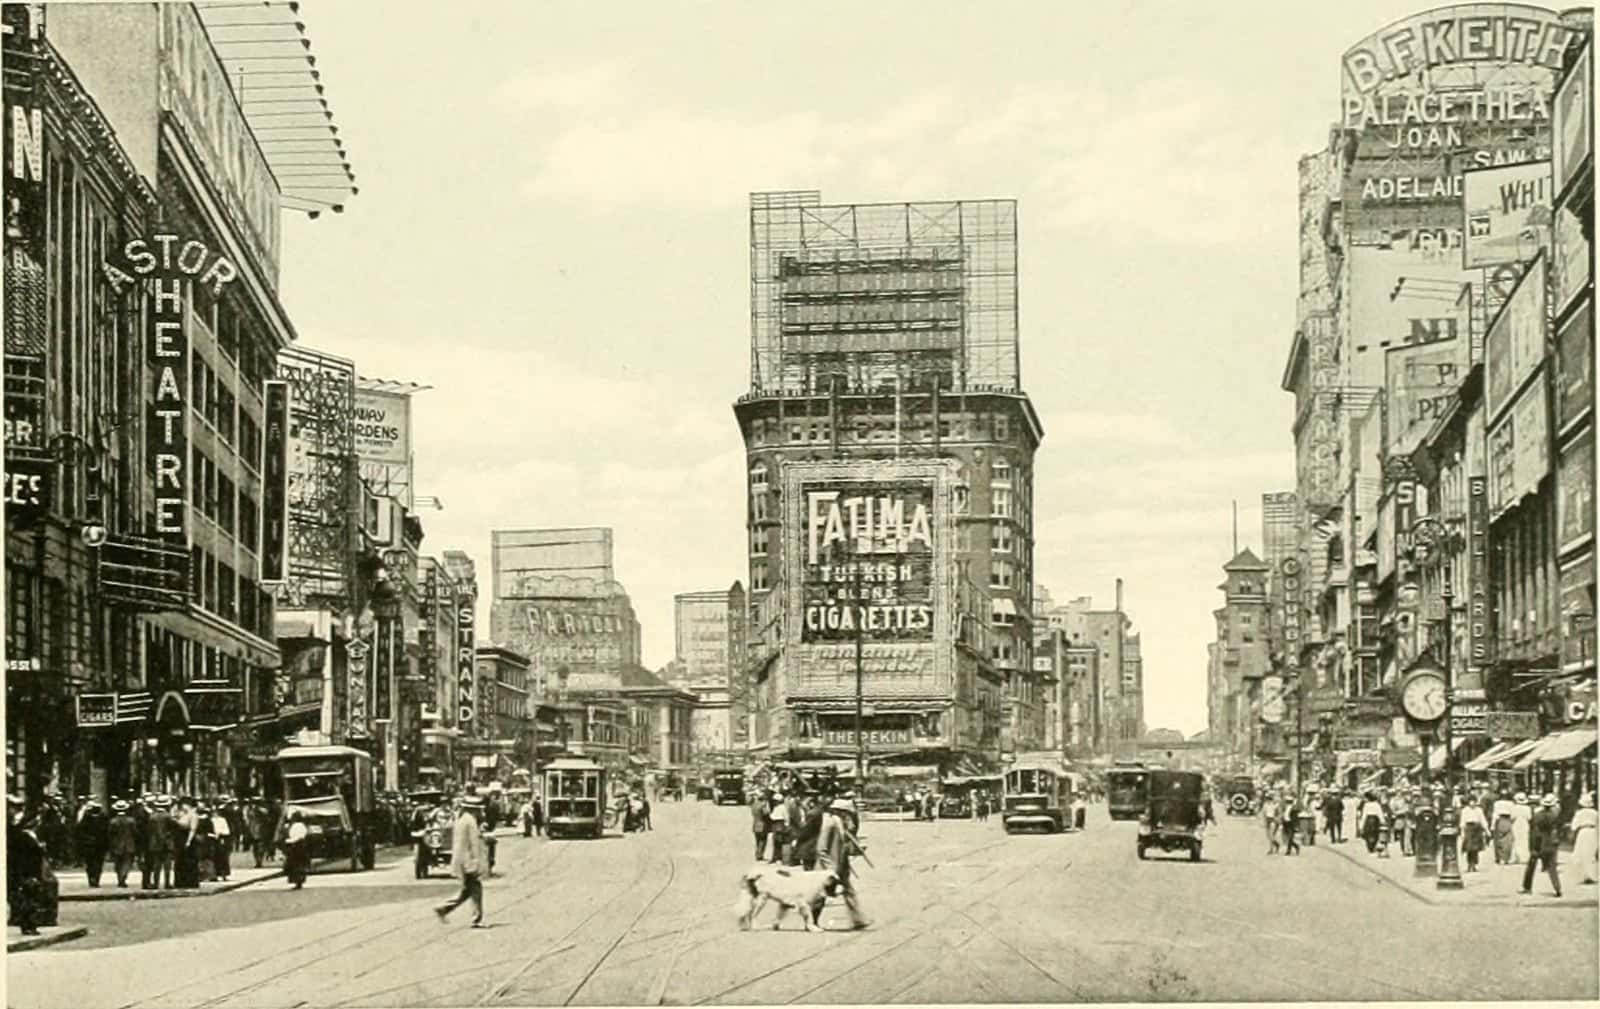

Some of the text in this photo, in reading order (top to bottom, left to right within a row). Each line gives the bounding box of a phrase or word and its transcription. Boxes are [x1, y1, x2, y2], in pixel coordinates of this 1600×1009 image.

[1344, 94, 1460, 130] PALACE
[1388, 126, 1462, 148] JOAN
[103, 234, 236, 295] ASTOR
[808, 491, 932, 565] FATIMA
[1472, 480, 1485, 658] BILLIARDS
[806, 605, 931, 632] CIGARETTES
[459, 607, 474, 722] STRAND
[828, 731, 907, 744] THE PEKIN
